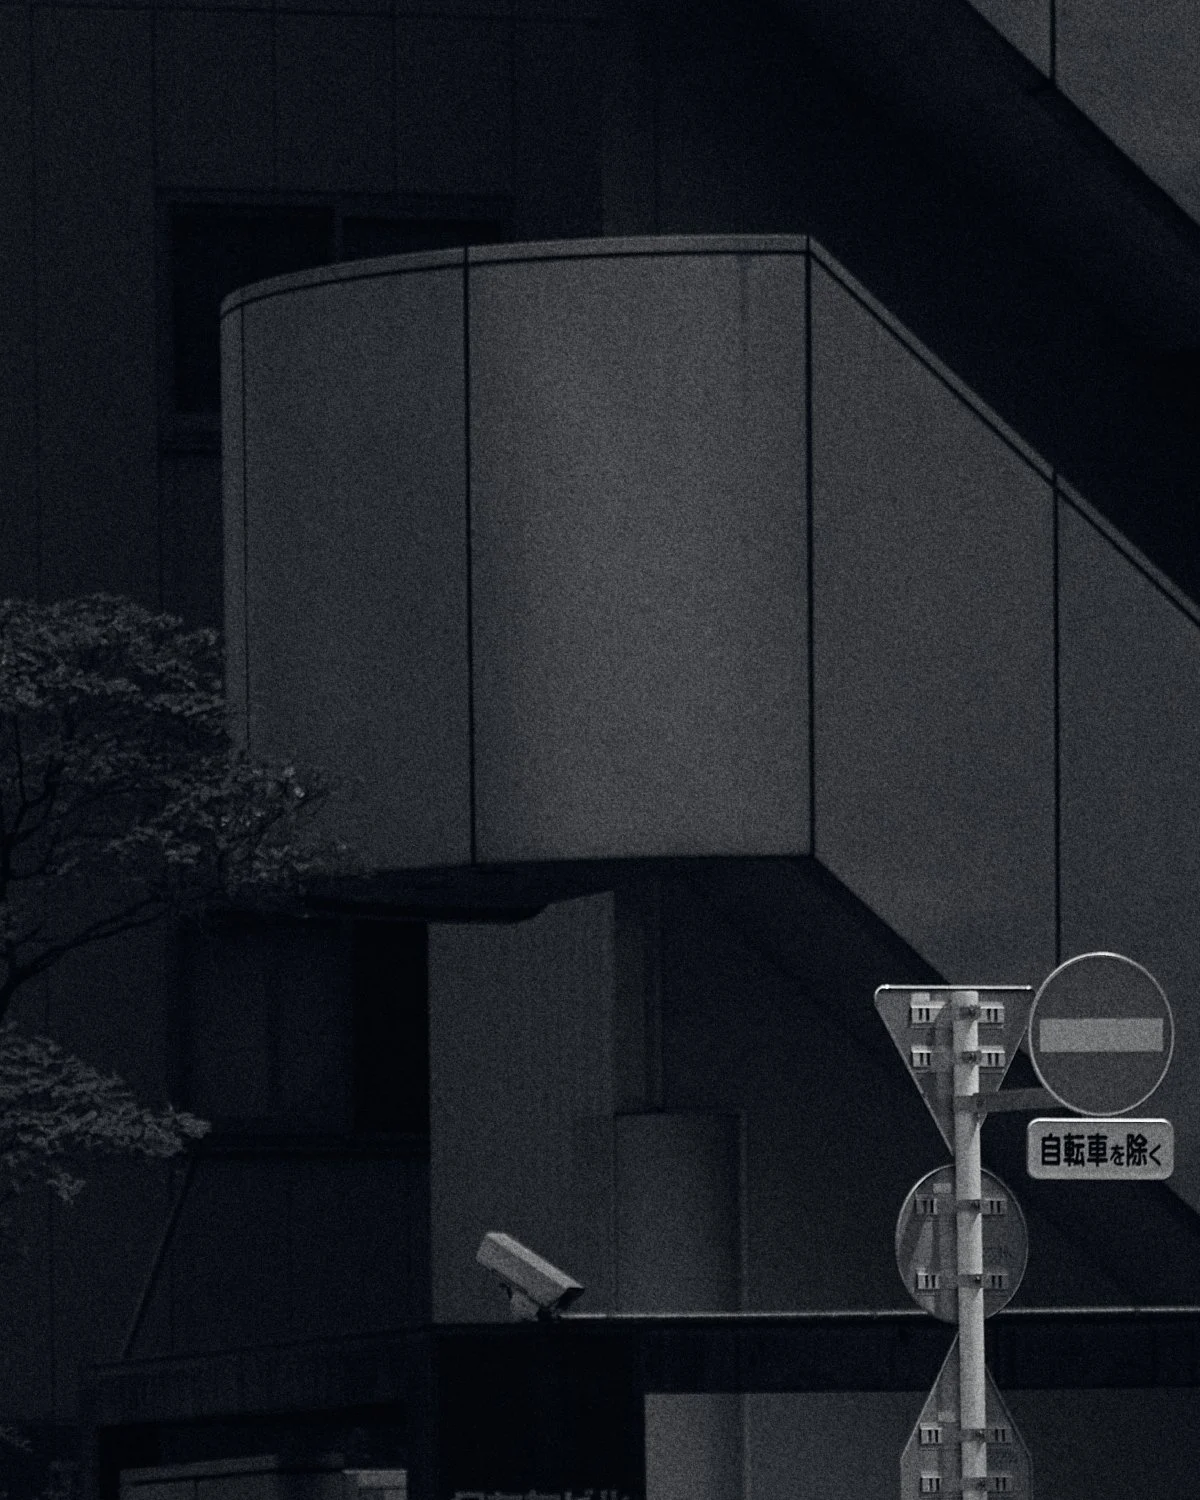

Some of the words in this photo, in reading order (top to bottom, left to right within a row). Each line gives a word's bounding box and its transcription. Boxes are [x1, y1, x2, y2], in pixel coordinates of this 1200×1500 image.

[1040, 1132, 1162, 1168] 自転車を除く
